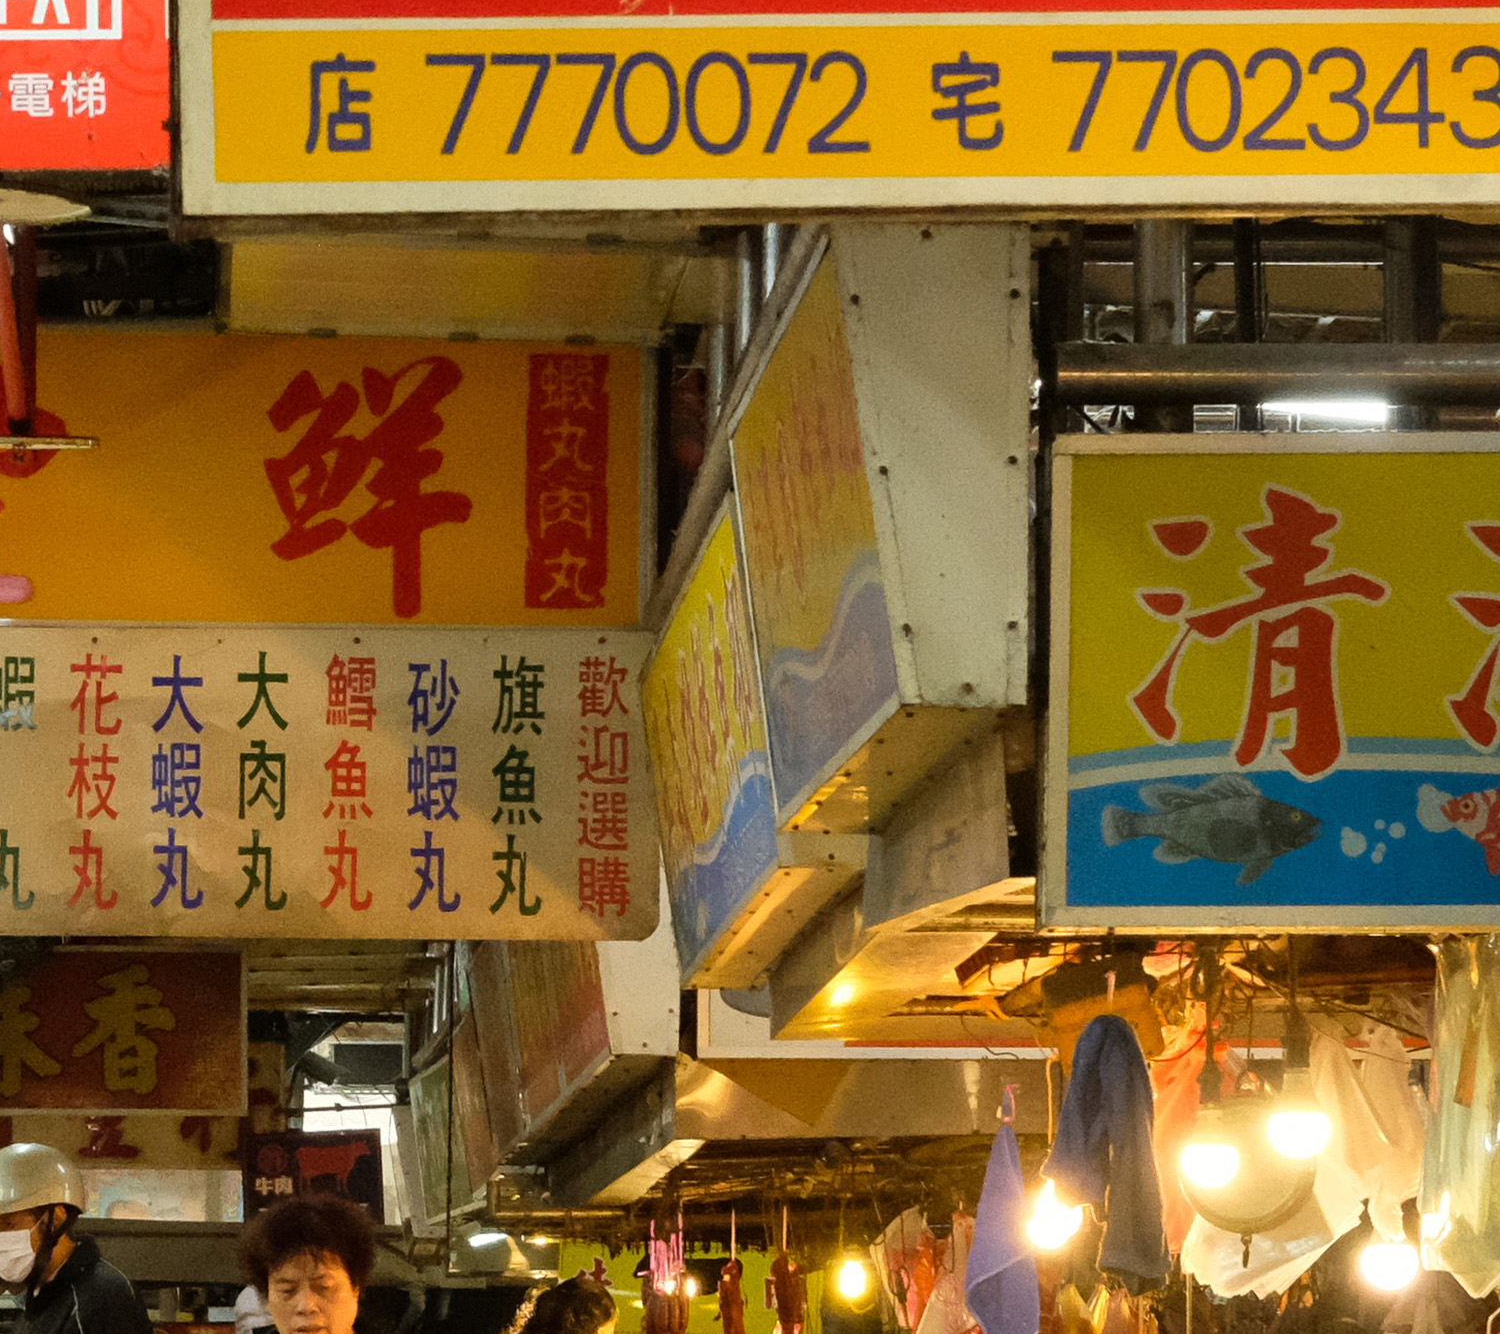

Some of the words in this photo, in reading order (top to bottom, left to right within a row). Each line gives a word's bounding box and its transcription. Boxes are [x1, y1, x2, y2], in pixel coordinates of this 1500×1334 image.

[6, 70, 108, 119] 電梯
[305, 53, 376, 153] 店
[425, 50, 871, 156] 7770072
[931, 50, 1003, 150] 宅
[537, 353, 605, 604] 蝦丸肉丸
[67, 651, 122, 915] 花枝丸
[150, 651, 204, 915] 大蝦丸
[235, 651, 290, 915] 大肉丸
[405, 654, 462, 915] 砂蝦丸
[490, 654, 546, 915] 旗魚丸
[575, 654, 631, 918] 歡迎選購
